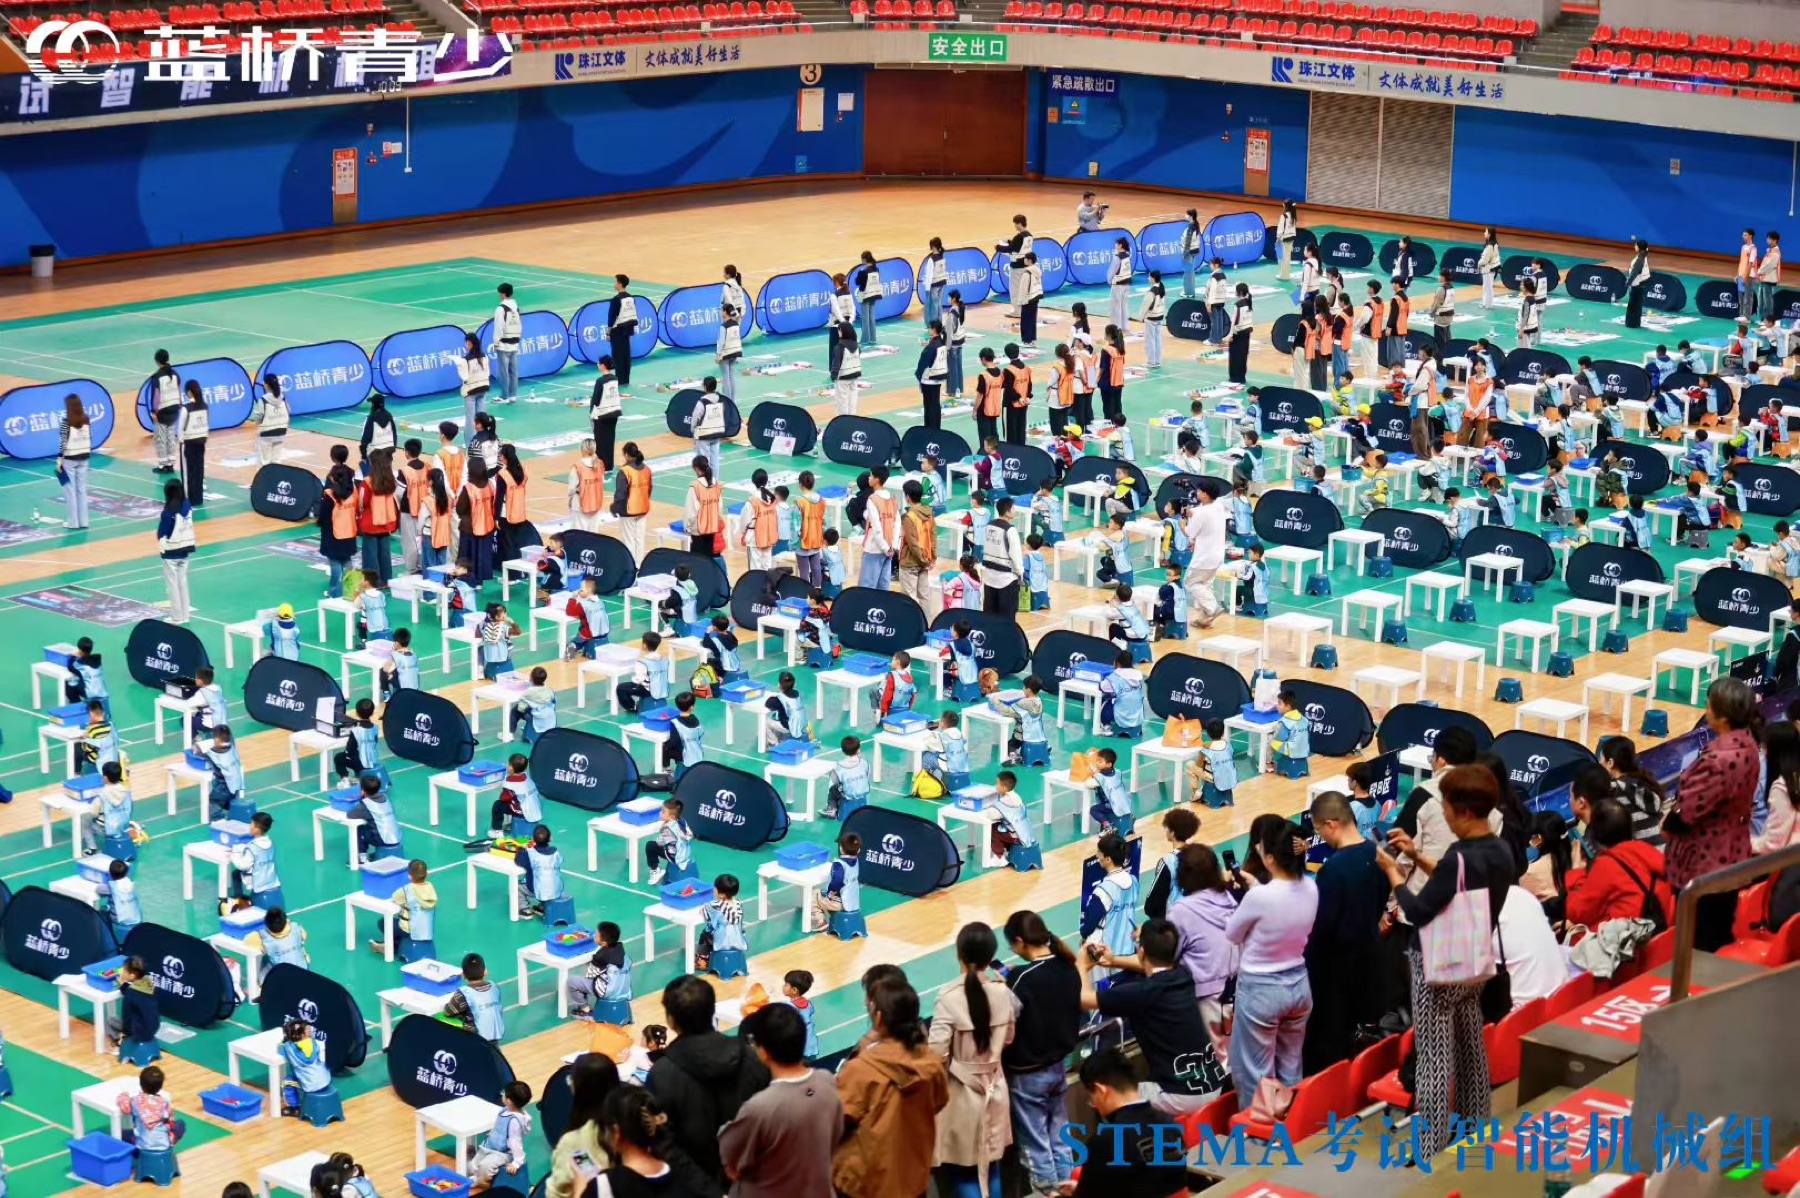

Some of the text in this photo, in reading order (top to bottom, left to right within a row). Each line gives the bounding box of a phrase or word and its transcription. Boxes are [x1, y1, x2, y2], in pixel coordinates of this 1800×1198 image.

[644, 44, 741, 68] 文体成就美好生活
[932, 37, 1004, 57] 安全出口
[578, 51, 626, 69] 珠江文体
[804, 63, 817, 83] 3
[1298, 60, 1356, 81] 珠江文体
[1051, 74, 1115, 93] 紧急疏散出口
[1379, 70, 1504, 99] 文体成就美好生活
[1225, 228, 1263, 247] 蓝桥青少
[784, 290, 832, 313] 蓝桥青少
[294, 363, 364, 389] 蓝桥青少
[1274, 518, 1311, 532] 蓝桥青少
[1717, 599, 1760, 614] 蓝桥青少
[854, 621, 896, 637] 蓝桥青少
[265, 694, 305, 712] 蓝桥青少
[1170, 690, 1213, 709] 蓝桥青少
[404, 727, 441, 747] 蓝桥青少
[554, 768, 598, 788] 蓝桥青少
[698, 803, 746, 826] 蓝桥青少
[865, 849, 915, 872] 蓝桥青少
[24, 933, 70, 960] 蓝桥青少
[416, 1066, 468, 1096] 蓝桥青少
